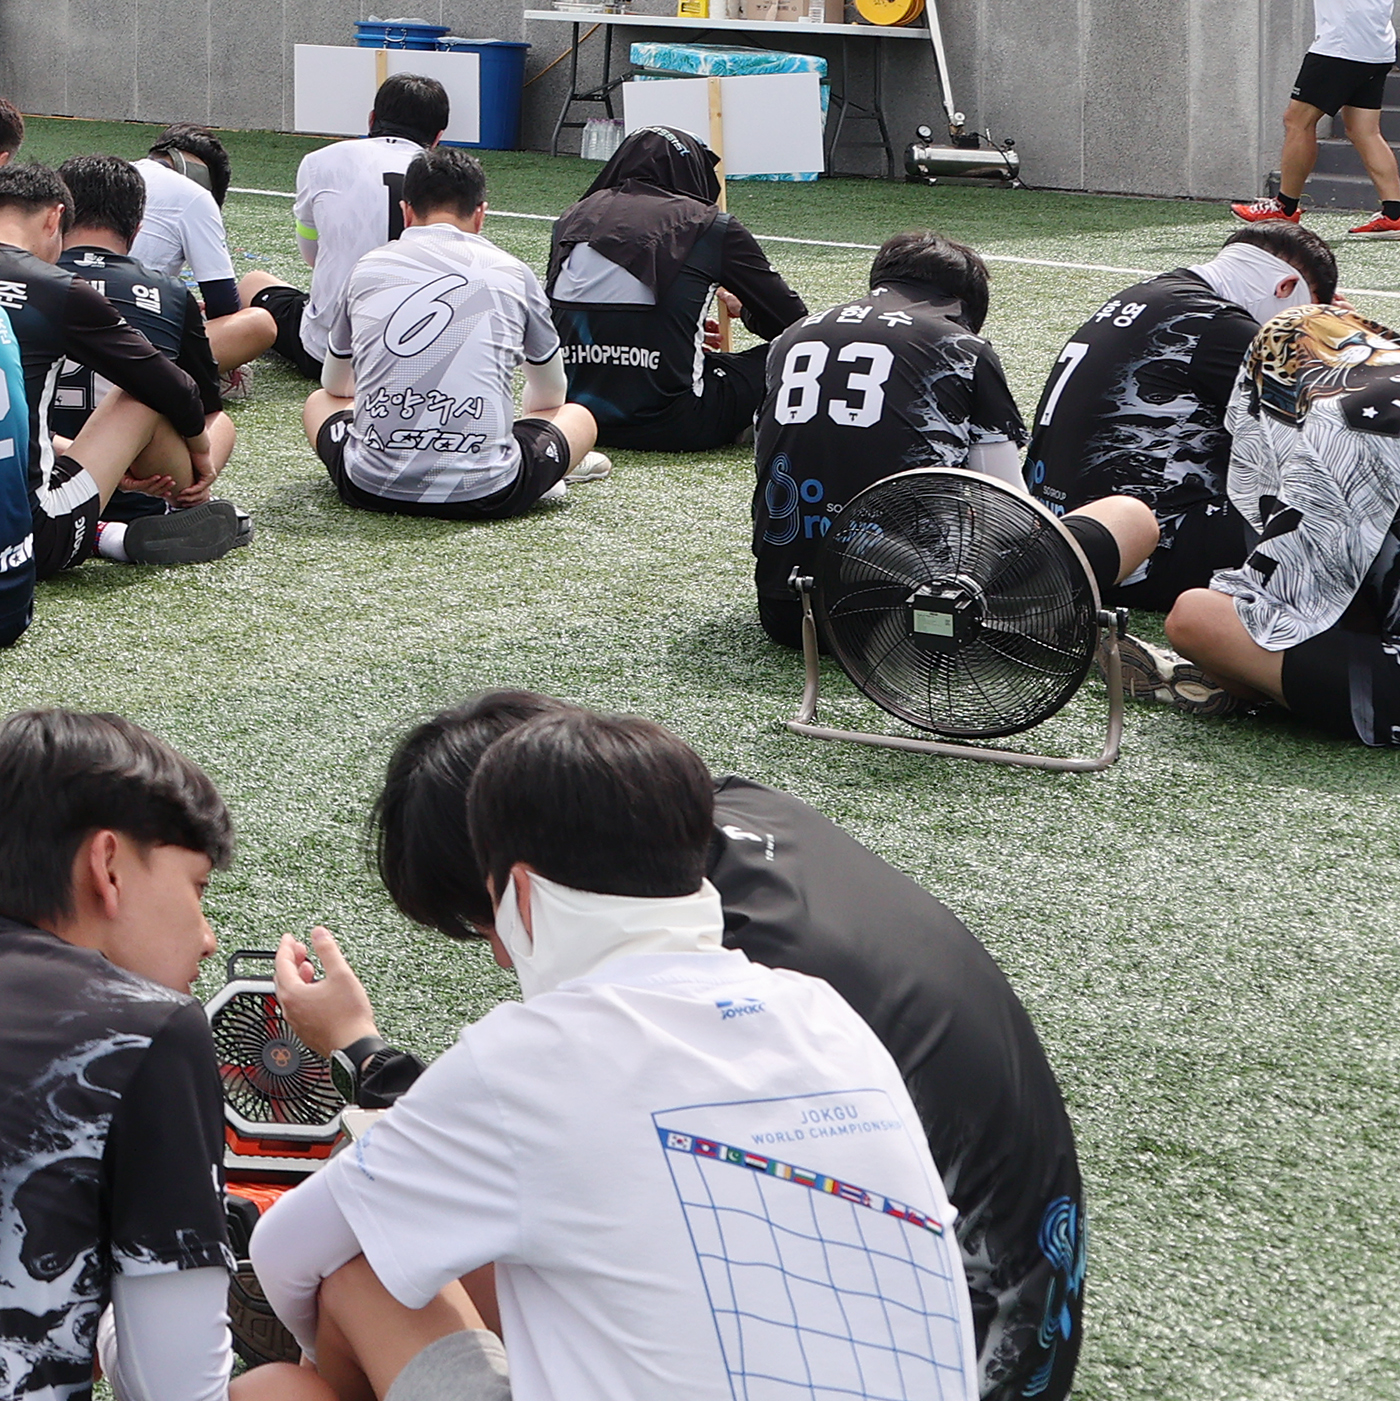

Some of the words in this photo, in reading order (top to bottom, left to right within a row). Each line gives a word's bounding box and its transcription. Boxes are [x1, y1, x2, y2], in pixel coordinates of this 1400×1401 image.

[383, 273, 469, 359] 6
[364, 386, 485, 426] 남양주시
[774, 340, 895, 428] 83
[1038, 341, 1090, 427] 7
[751, 1130, 806, 1146] WORLD
[799, 1105, 859, 1125] JOKGU
